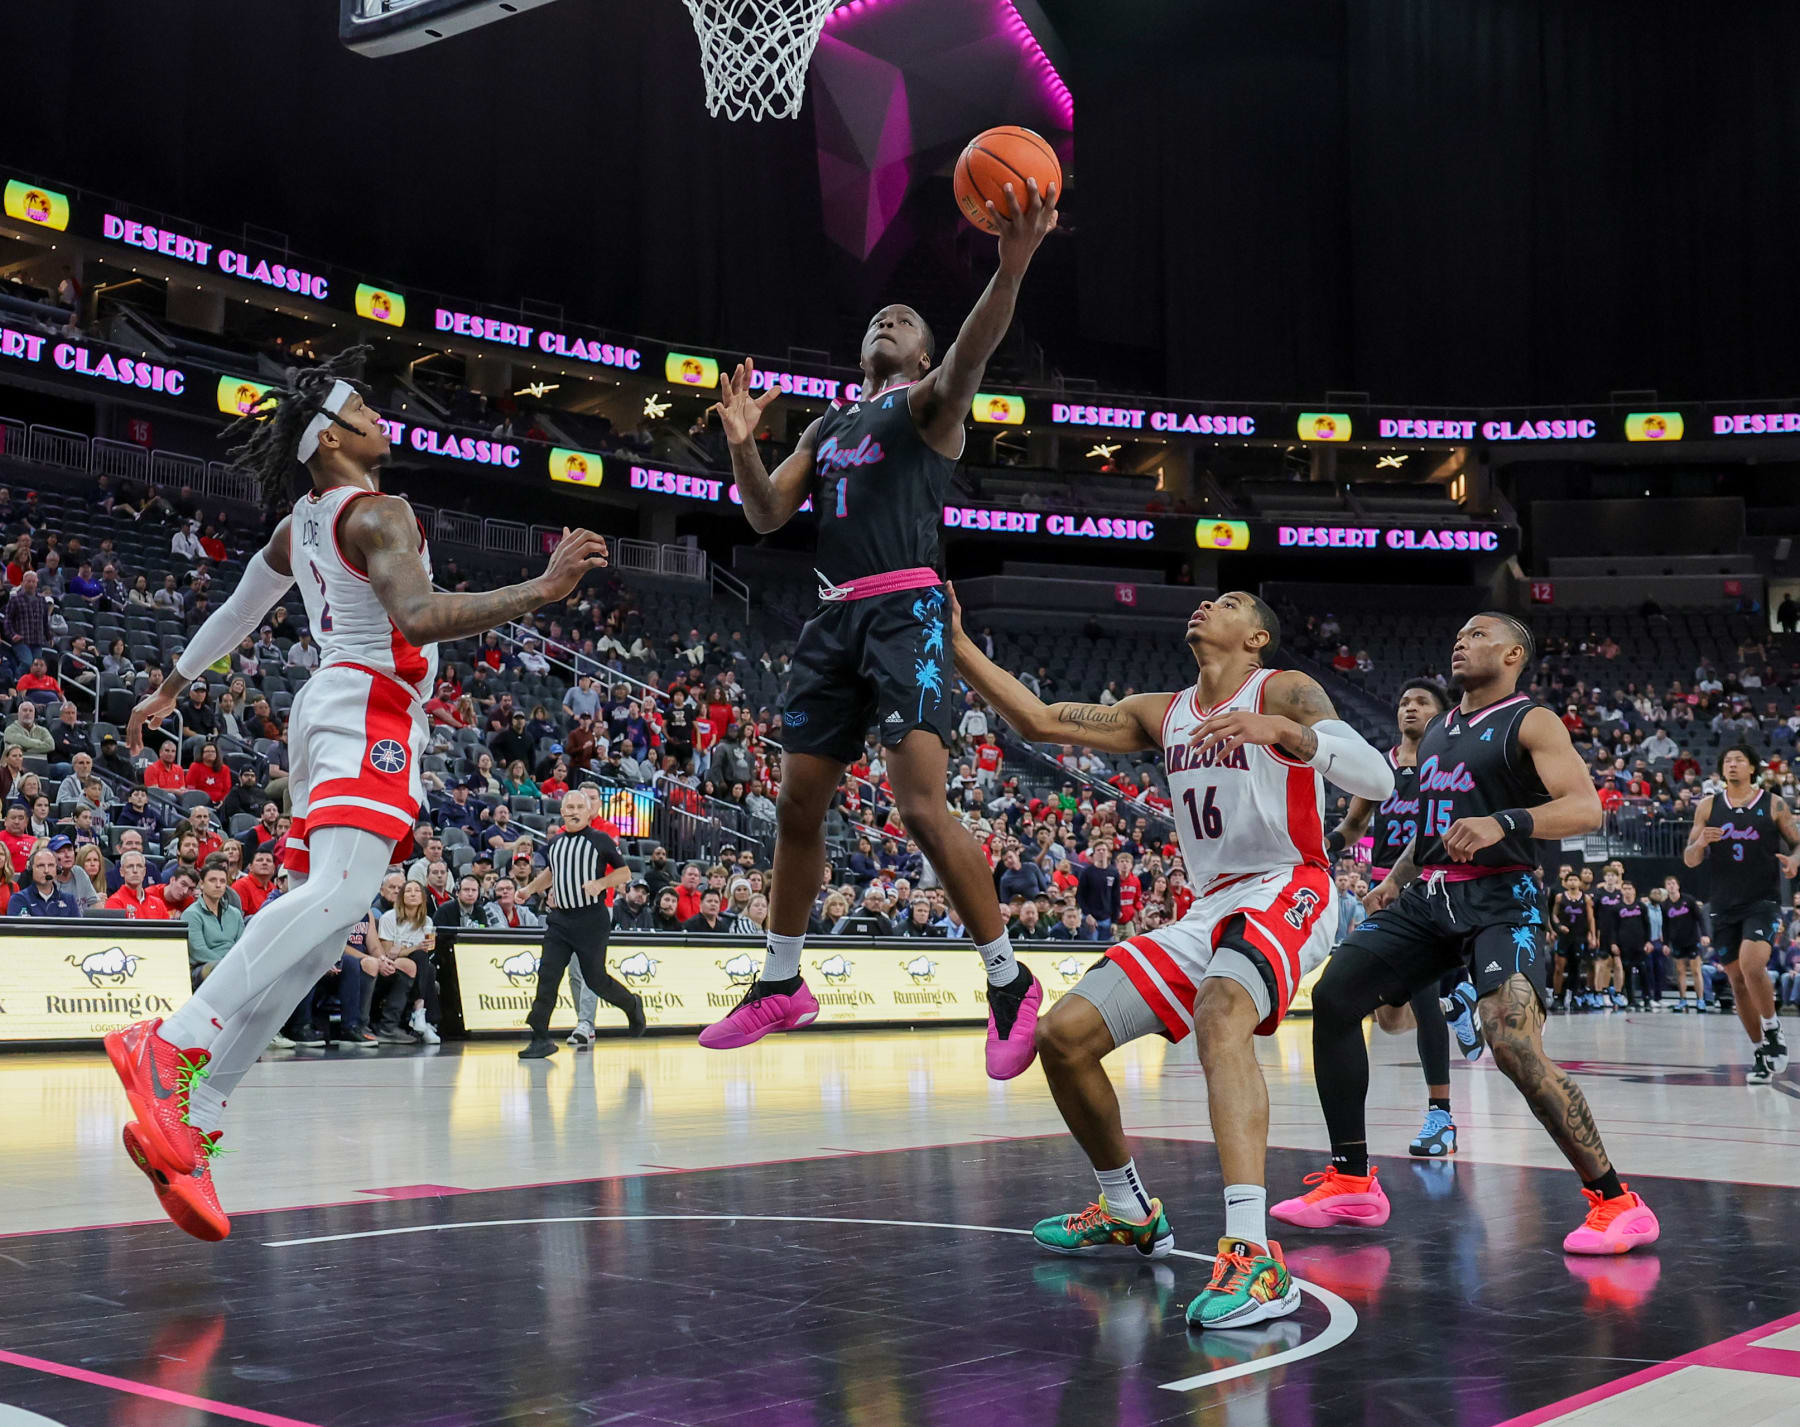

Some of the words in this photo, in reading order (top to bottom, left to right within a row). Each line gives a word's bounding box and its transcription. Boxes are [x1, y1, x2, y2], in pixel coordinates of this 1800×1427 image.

[104, 213, 212, 265] DESERT
[218, 249, 328, 300] CLASSIC
[435, 309, 533, 347] DESERT
[539, 331, 641, 370] CLASSIC
[54, 344, 185, 396] CLASSIC
[750, 369, 840, 400] DESERT
[1052, 403, 1146, 428] DESERT
[1150, 412, 1256, 435] CLASSIC
[1379, 419, 1477, 440] DESERT
[1482, 419, 1597, 440] CLASSIC
[1713, 413, 1800, 434] DESER
[133, 424, 148, 443] 15
[411, 427, 520, 468] CLASSIC
[816, 433, 885, 477] Owls
[630, 466, 723, 501] DESERT
[836, 477, 848, 518] 1
[943, 506, 1041, 533] DESERT
[1046, 515, 1155, 540] CLASSIC
[1279, 527, 1380, 548] DESERT
[1386, 529, 1498, 550] CLASSIC
[309, 560, 333, 632] 2
[1120, 590, 1133, 604] 13
[1533, 585, 1551, 600] 12
[1057, 704, 1120, 724] Oakland
[1420, 754, 1476, 792] Owls
[1182, 785, 1223, 840] 16
[1424, 799, 1454, 836] 15
[1387, 819, 1417, 846] 23
[1720, 822, 1760, 840] Owls
[1732, 843, 1744, 861] 3
[46, 992, 142, 1018] Running
[145, 996, 173, 1013] Ox
[479, 992, 536, 1010] Runni
[665, 992, 684, 1008] Ox
[859, 991, 876, 1005] Ox
[893, 988, 942, 1008] Running
[943, 990, 958, 1003] Ox
